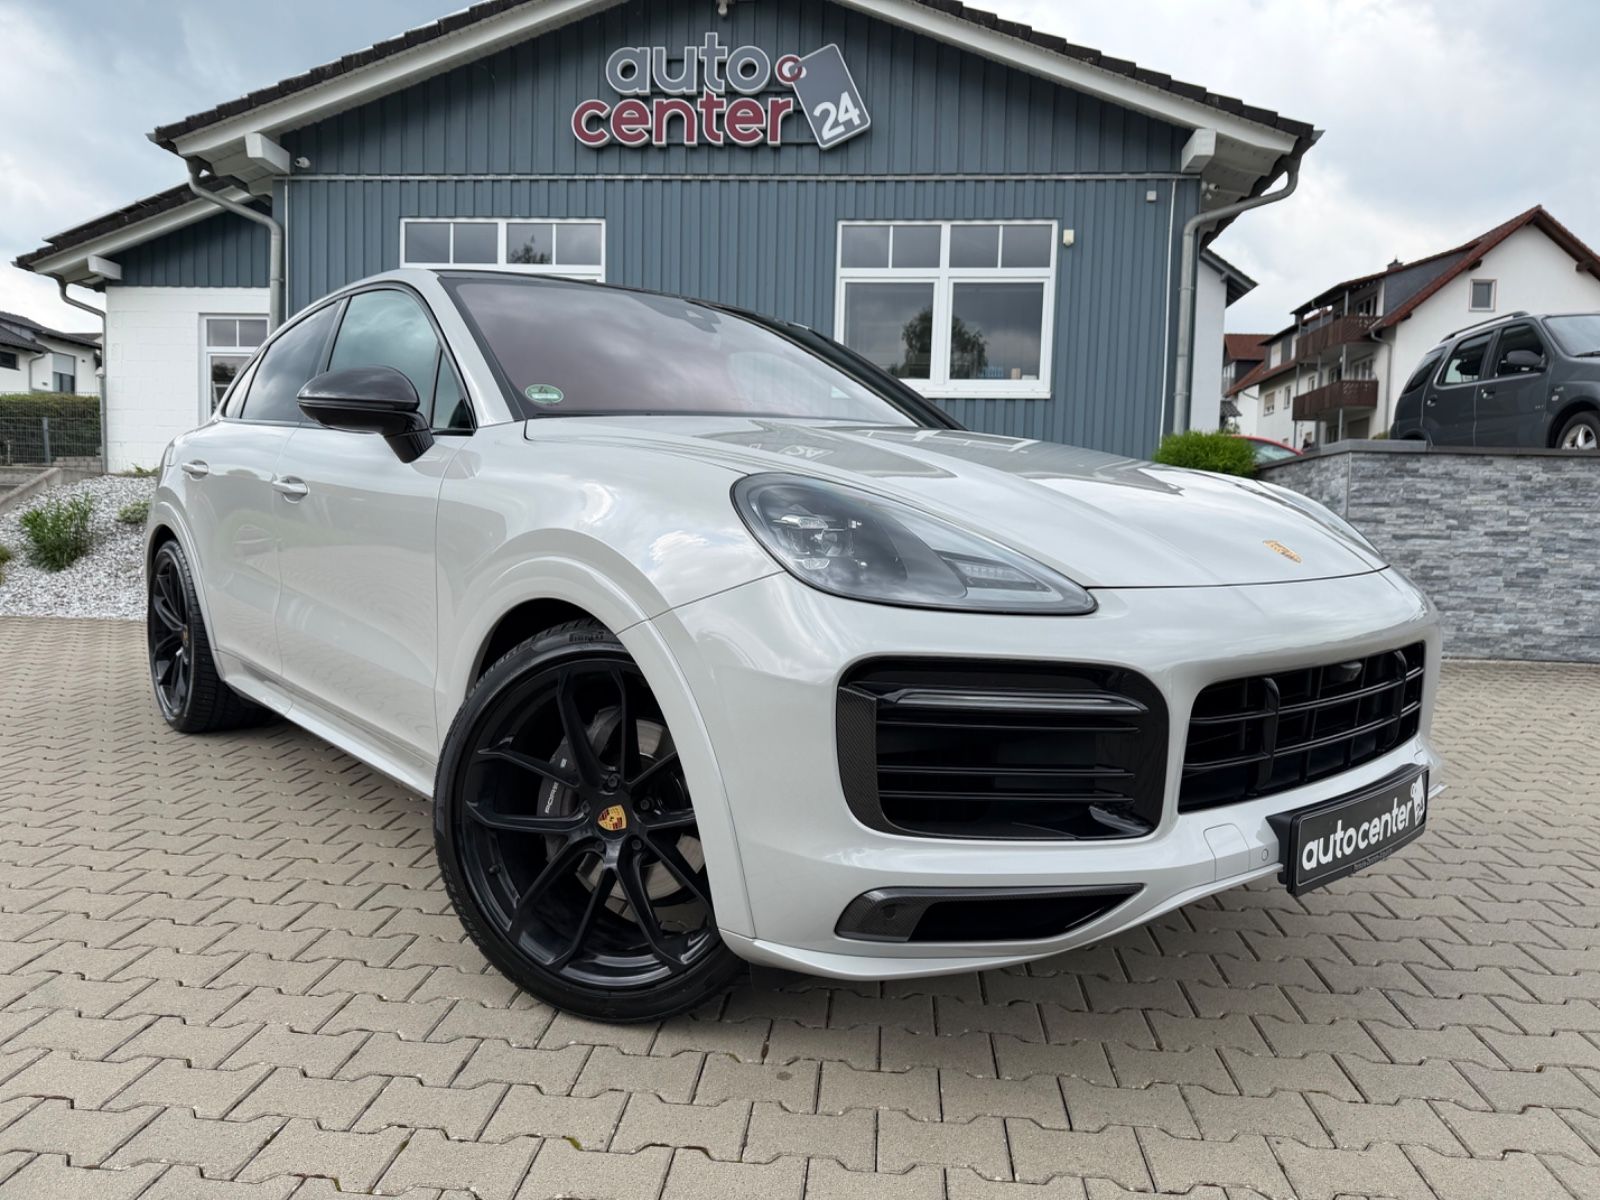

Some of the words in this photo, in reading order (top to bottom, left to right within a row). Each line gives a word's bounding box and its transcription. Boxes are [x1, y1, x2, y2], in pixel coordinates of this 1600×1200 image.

[606, 32, 770, 95] auto
[571, 89, 793, 147] center
[813, 91, 861, 140] 24
[1302, 797, 1413, 870] autocenter
